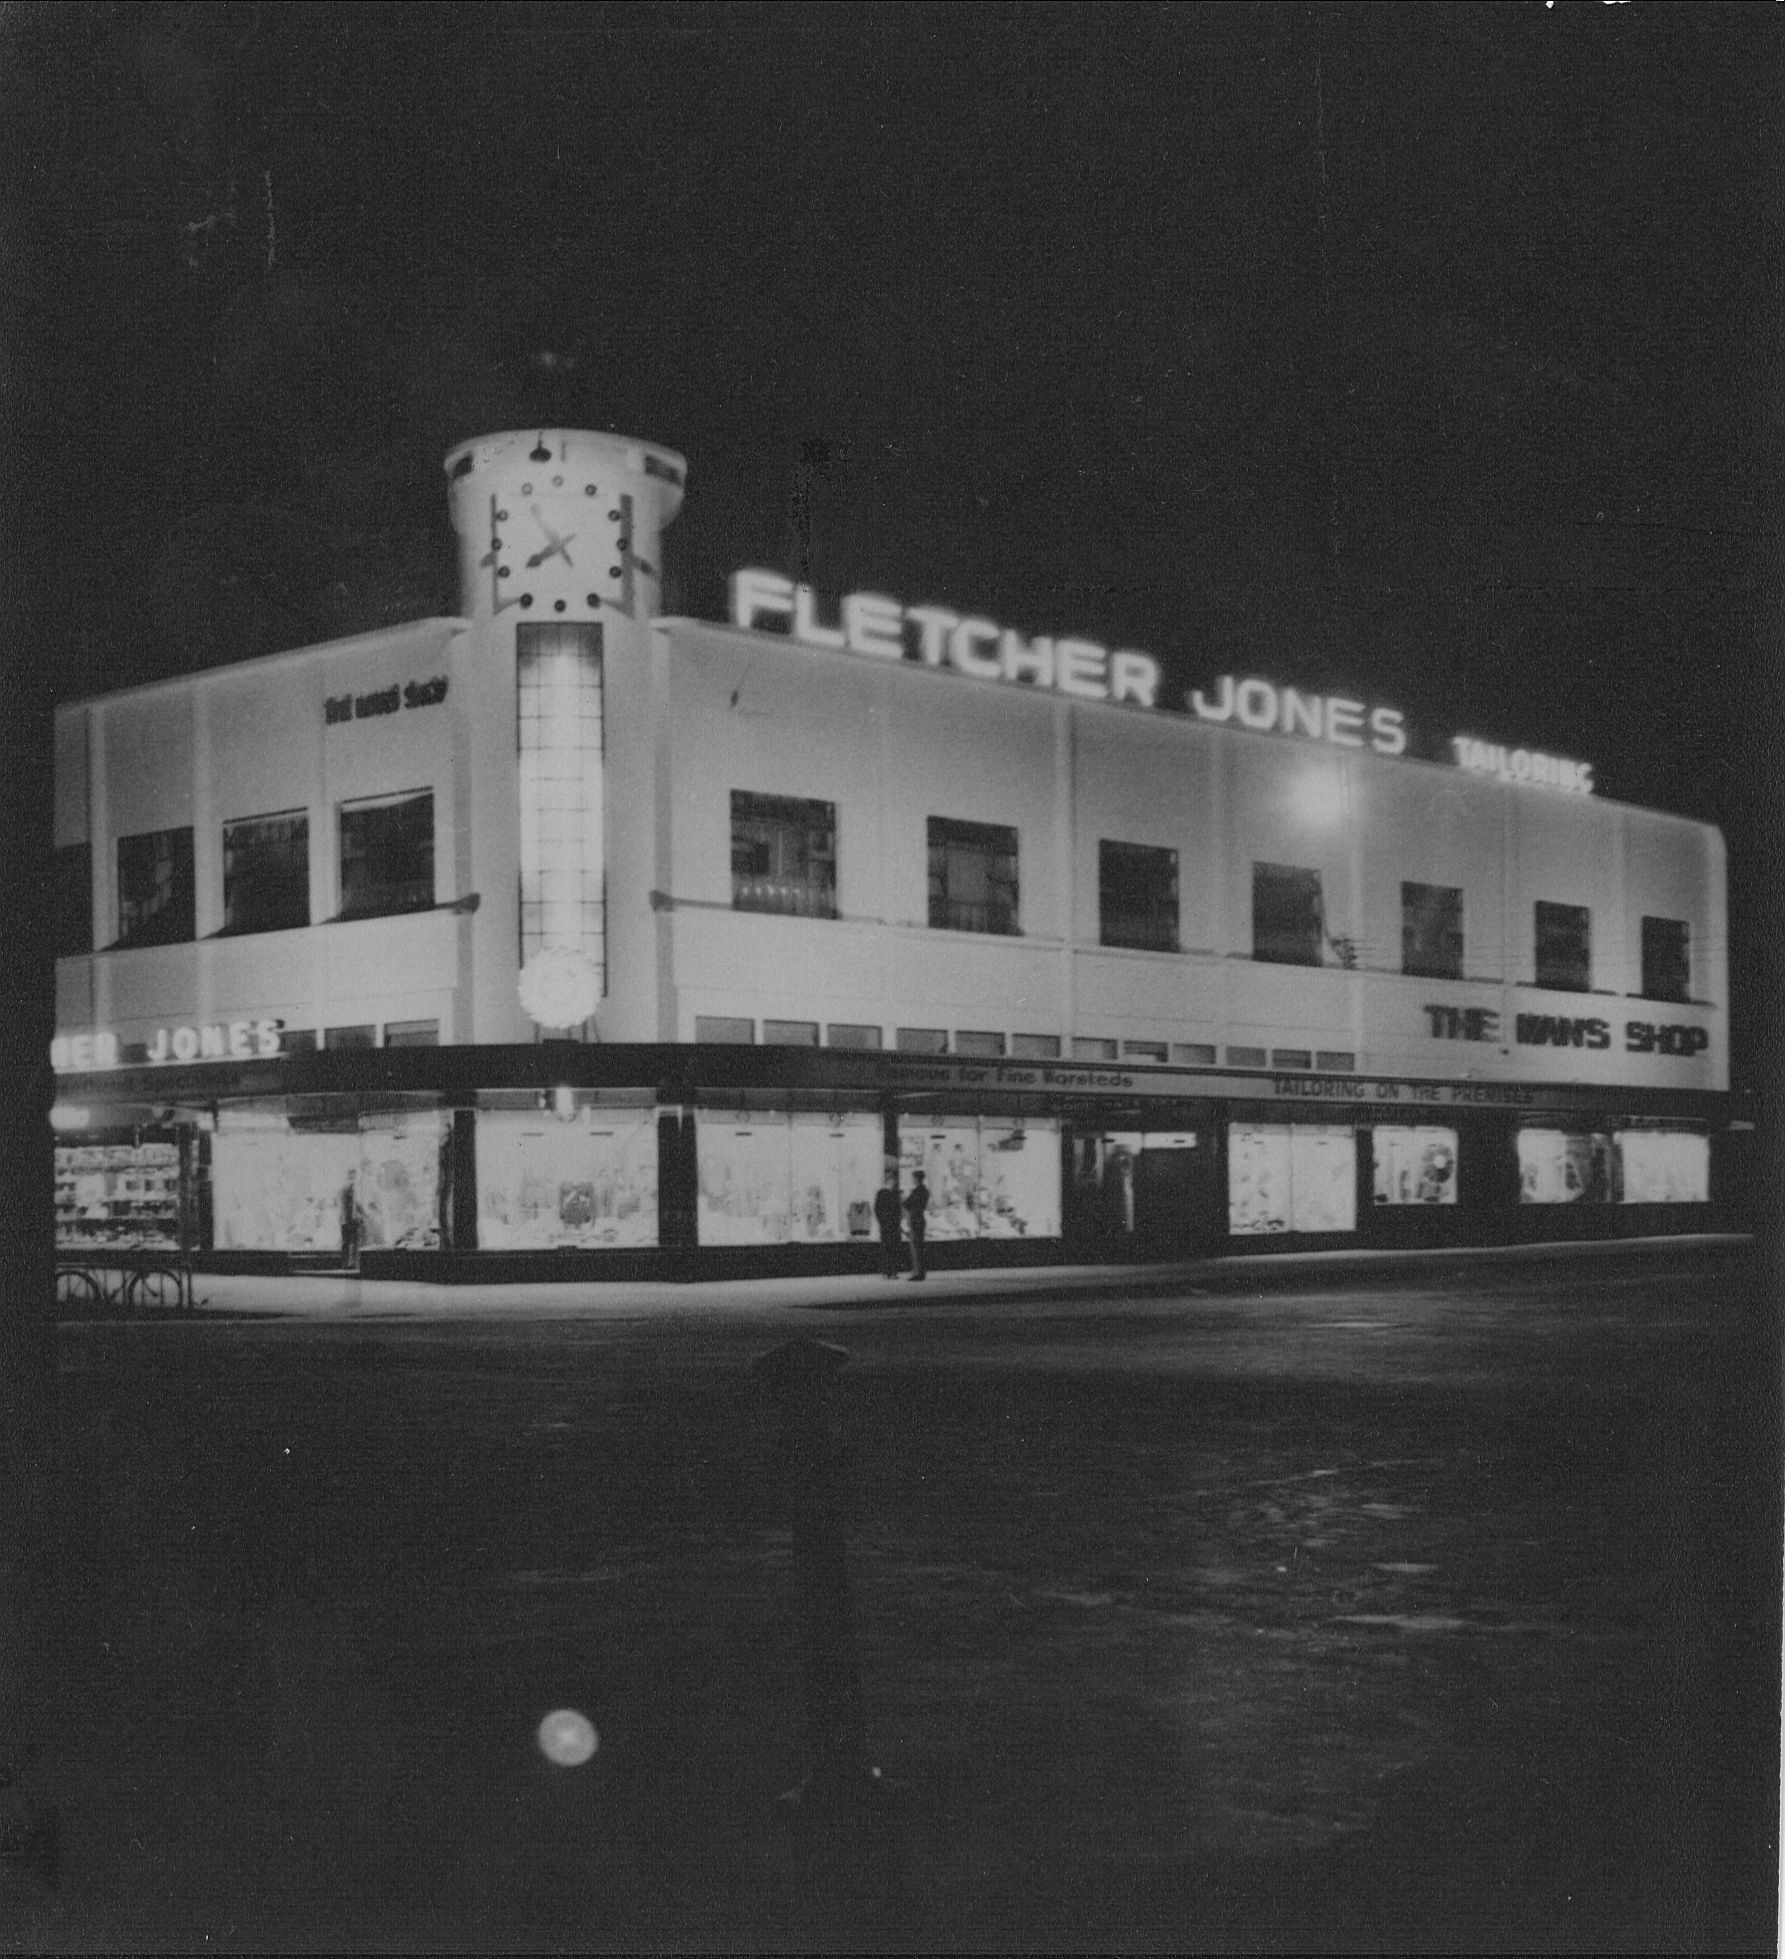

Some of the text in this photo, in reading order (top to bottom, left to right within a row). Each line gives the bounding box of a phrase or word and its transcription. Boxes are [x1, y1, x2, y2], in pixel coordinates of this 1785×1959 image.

[732, 568, 1407, 754] FLETCHER JONES
[1452, 735, 1595, 795] TAILORING
[146, 1020, 283, 1062] JONES
[1424, 1004, 1500, 1043] THE
[1624, 1020, 1709, 1057] SHOP
[1273, 1079, 1365, 1098] TAILORING
[1375, 1083, 1400, 1099] ON
[1412, 1084, 1441, 1101] THE
